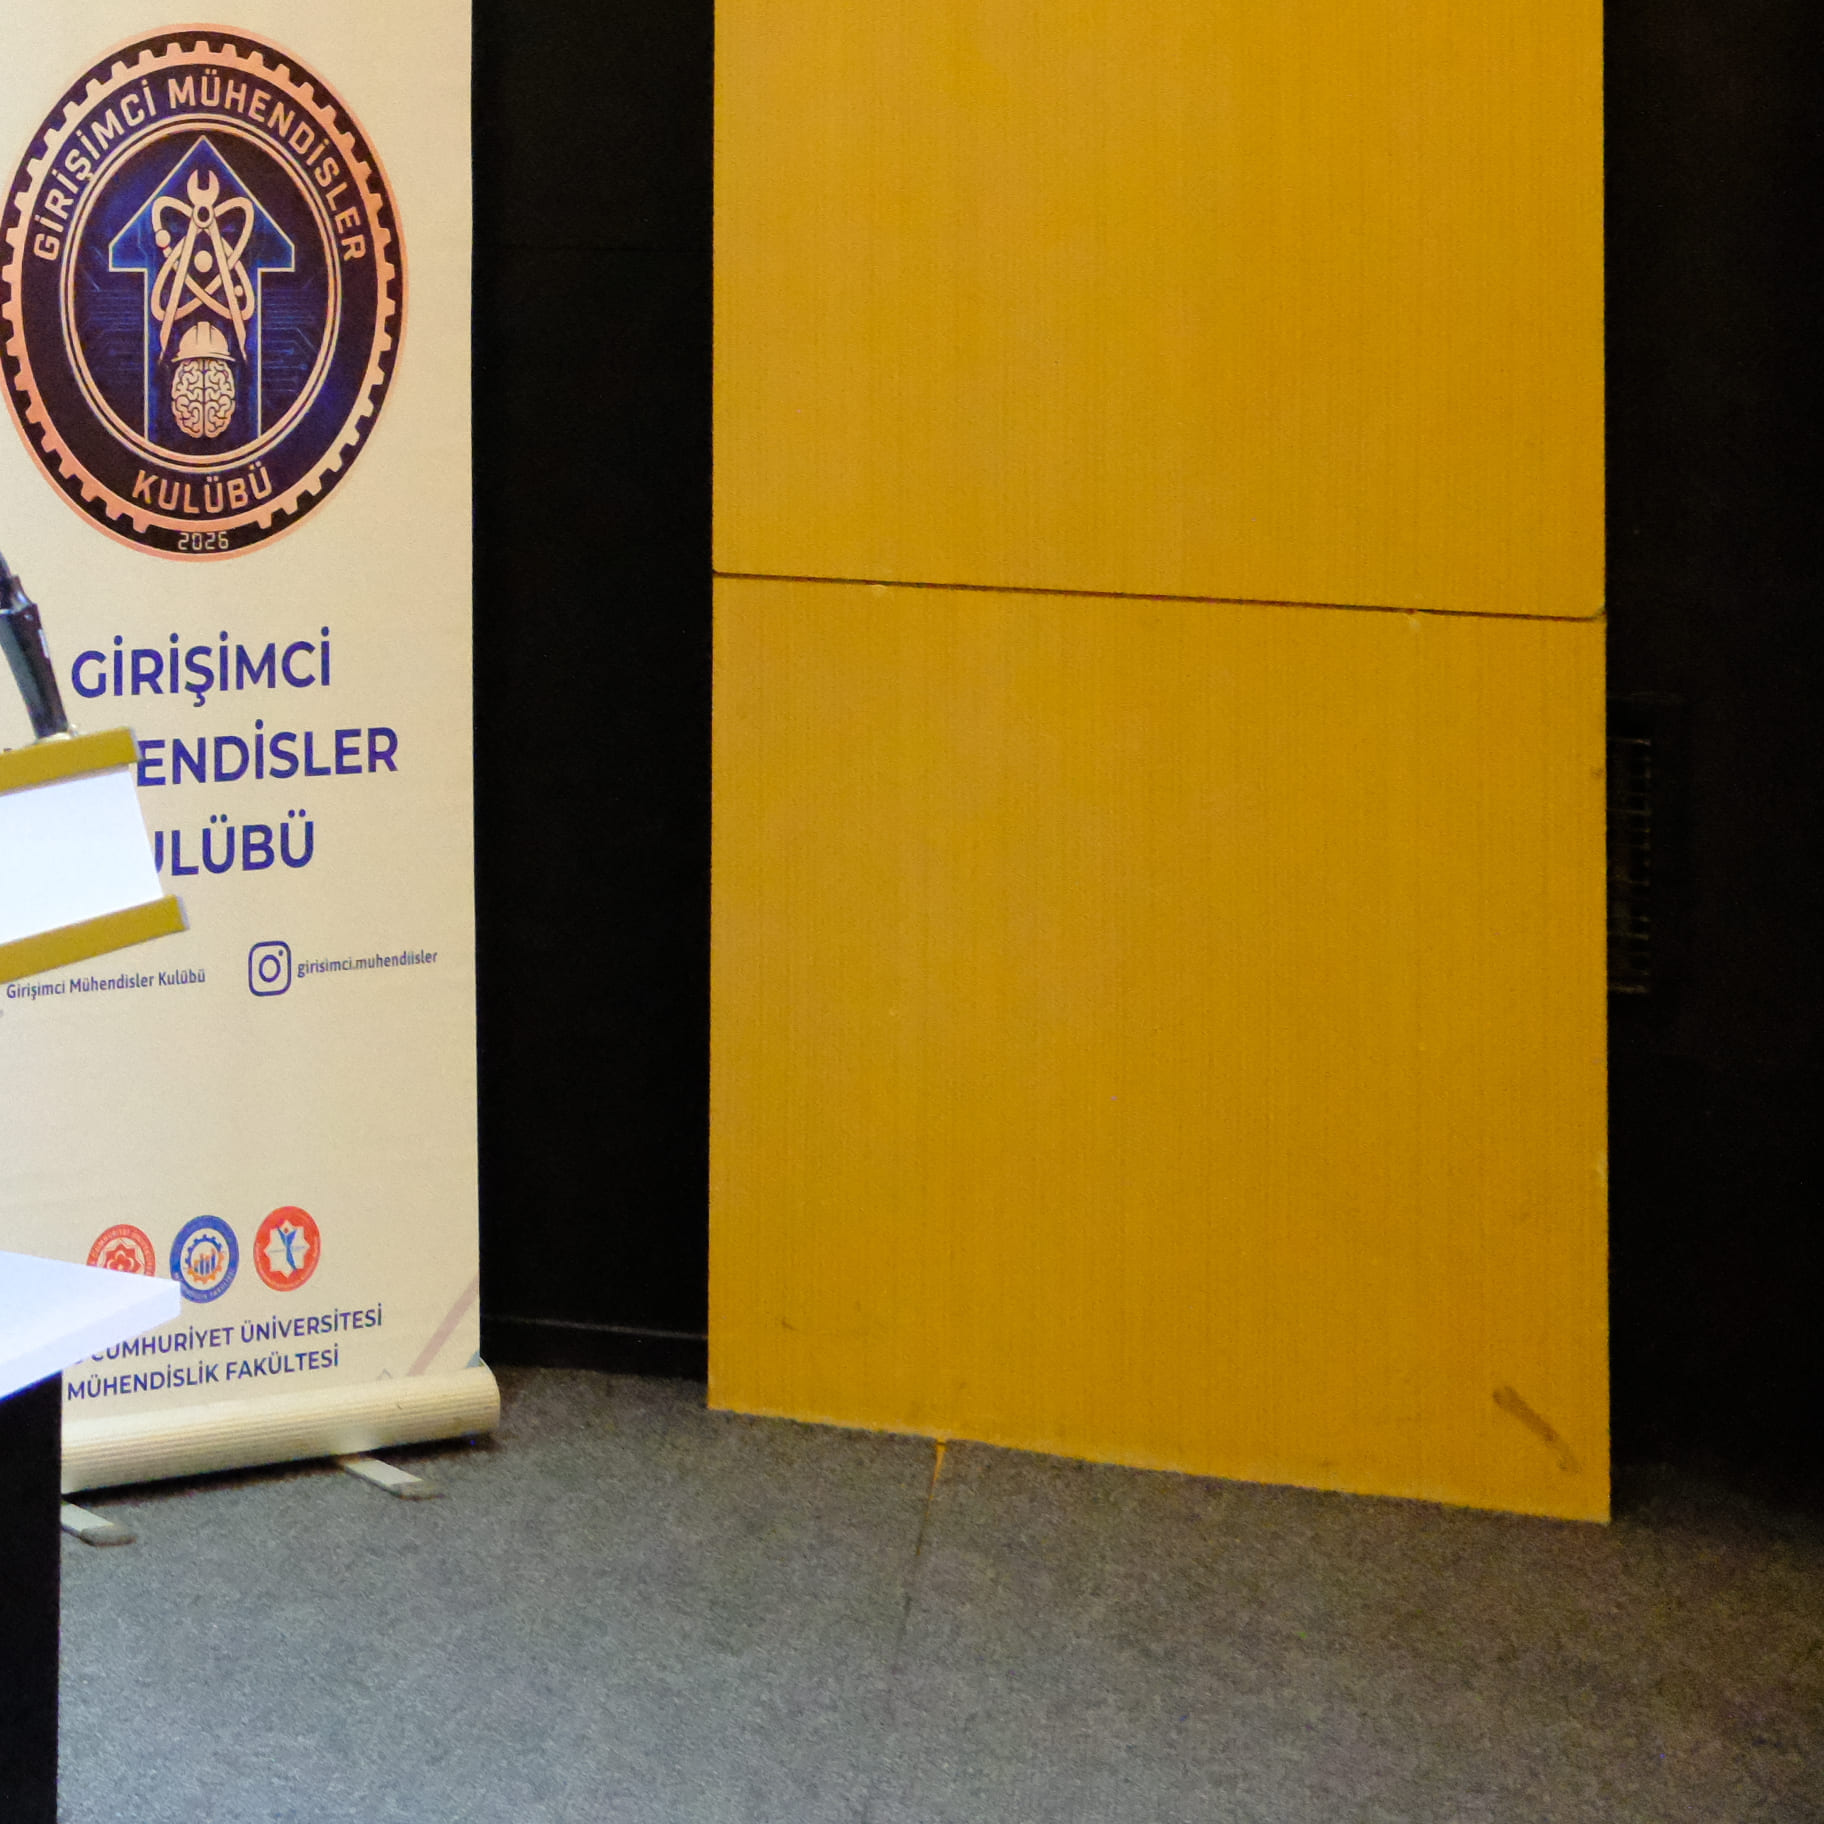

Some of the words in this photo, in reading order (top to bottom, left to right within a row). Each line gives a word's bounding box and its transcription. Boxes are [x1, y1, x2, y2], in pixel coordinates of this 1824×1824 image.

[33, 80, 157, 261] GİRİŞİMCİ
[168, 68, 366, 261] MÜHENDİSLER
[132, 461, 273, 514] KULÜBÜ
[178, 531, 229, 550] 2026
[71, 626, 331, 707] GİRİŞİMCİ
[136, 719, 399, 787] ENDİSLER
[154, 809, 315, 876] LÜBÜ
[6, 980, 66, 1000] Girişimci
[70, 973, 155, 994] Mühendisler
[158, 969, 206, 987] Kulübü
[240, 1303, 383, 1344] ÜNİVERSİTESİ
[67, 1361, 219, 1401] MÜHENDİSLİK
[226, 1343, 339, 1380] FAKÜLTESİ
